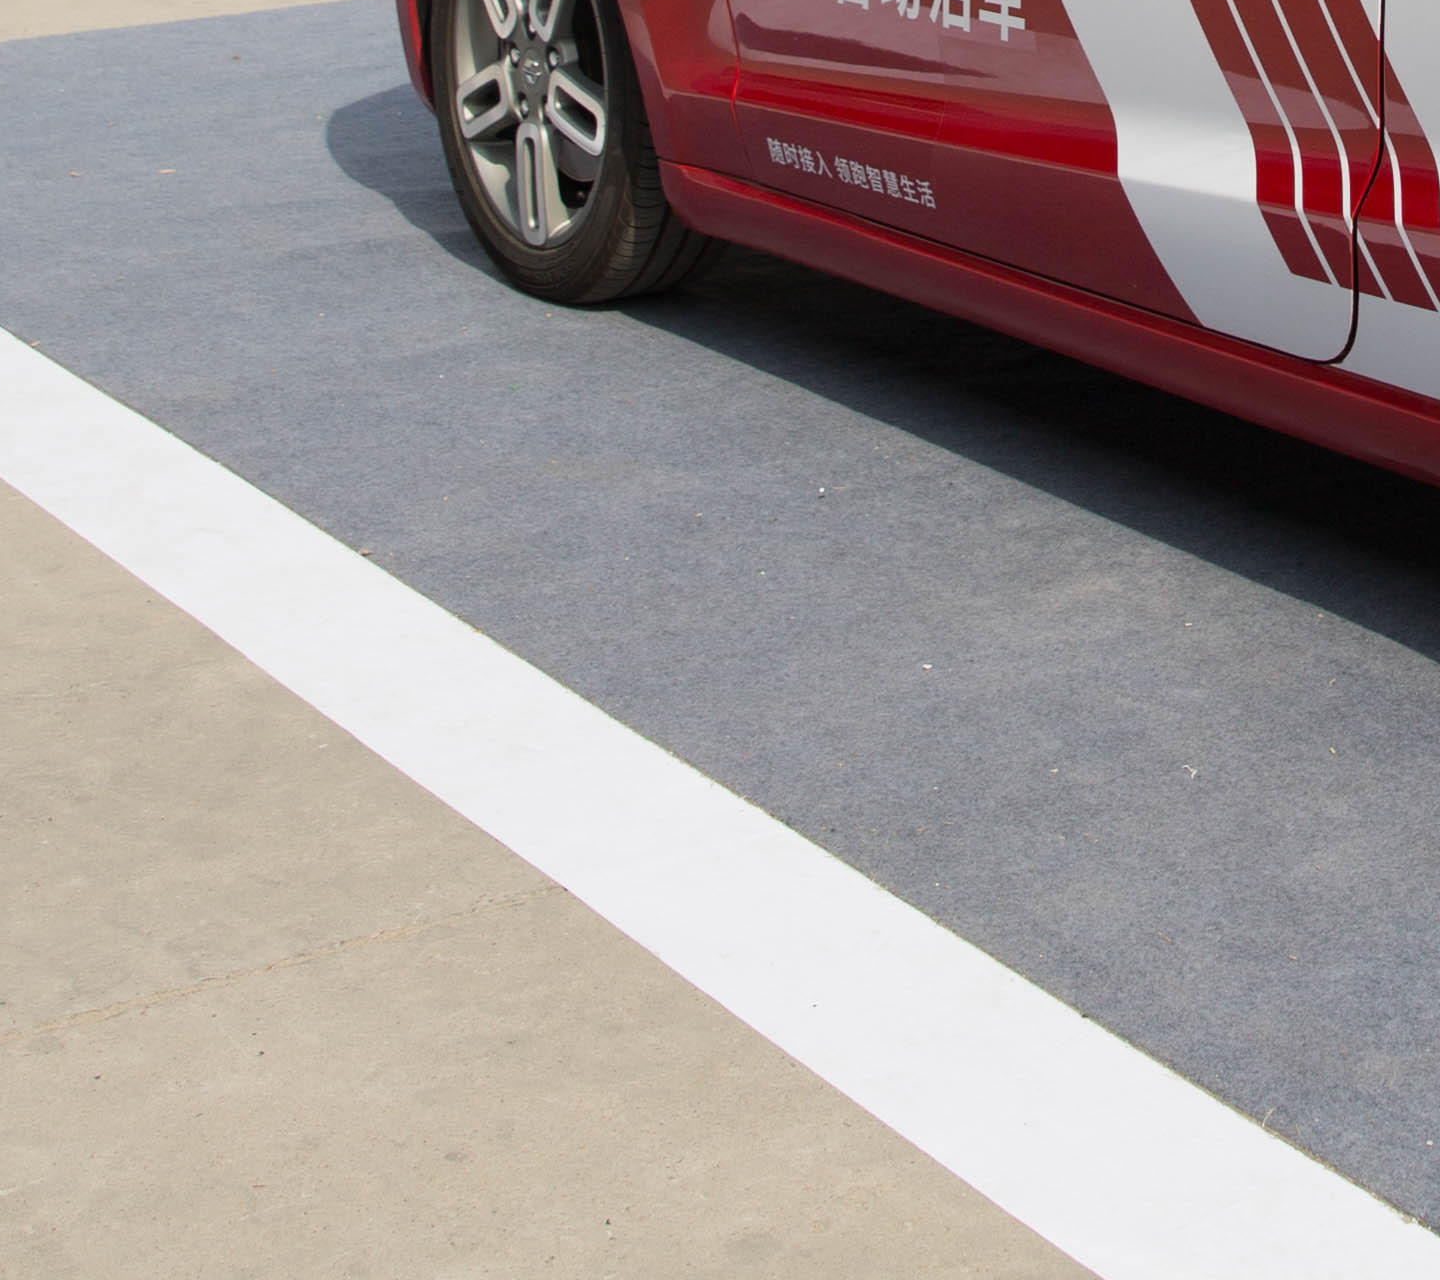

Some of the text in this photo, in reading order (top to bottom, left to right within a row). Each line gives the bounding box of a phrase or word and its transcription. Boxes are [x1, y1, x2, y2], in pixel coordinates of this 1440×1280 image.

[766, 137, 938, 210] 随时接入 领跑智慧生活
